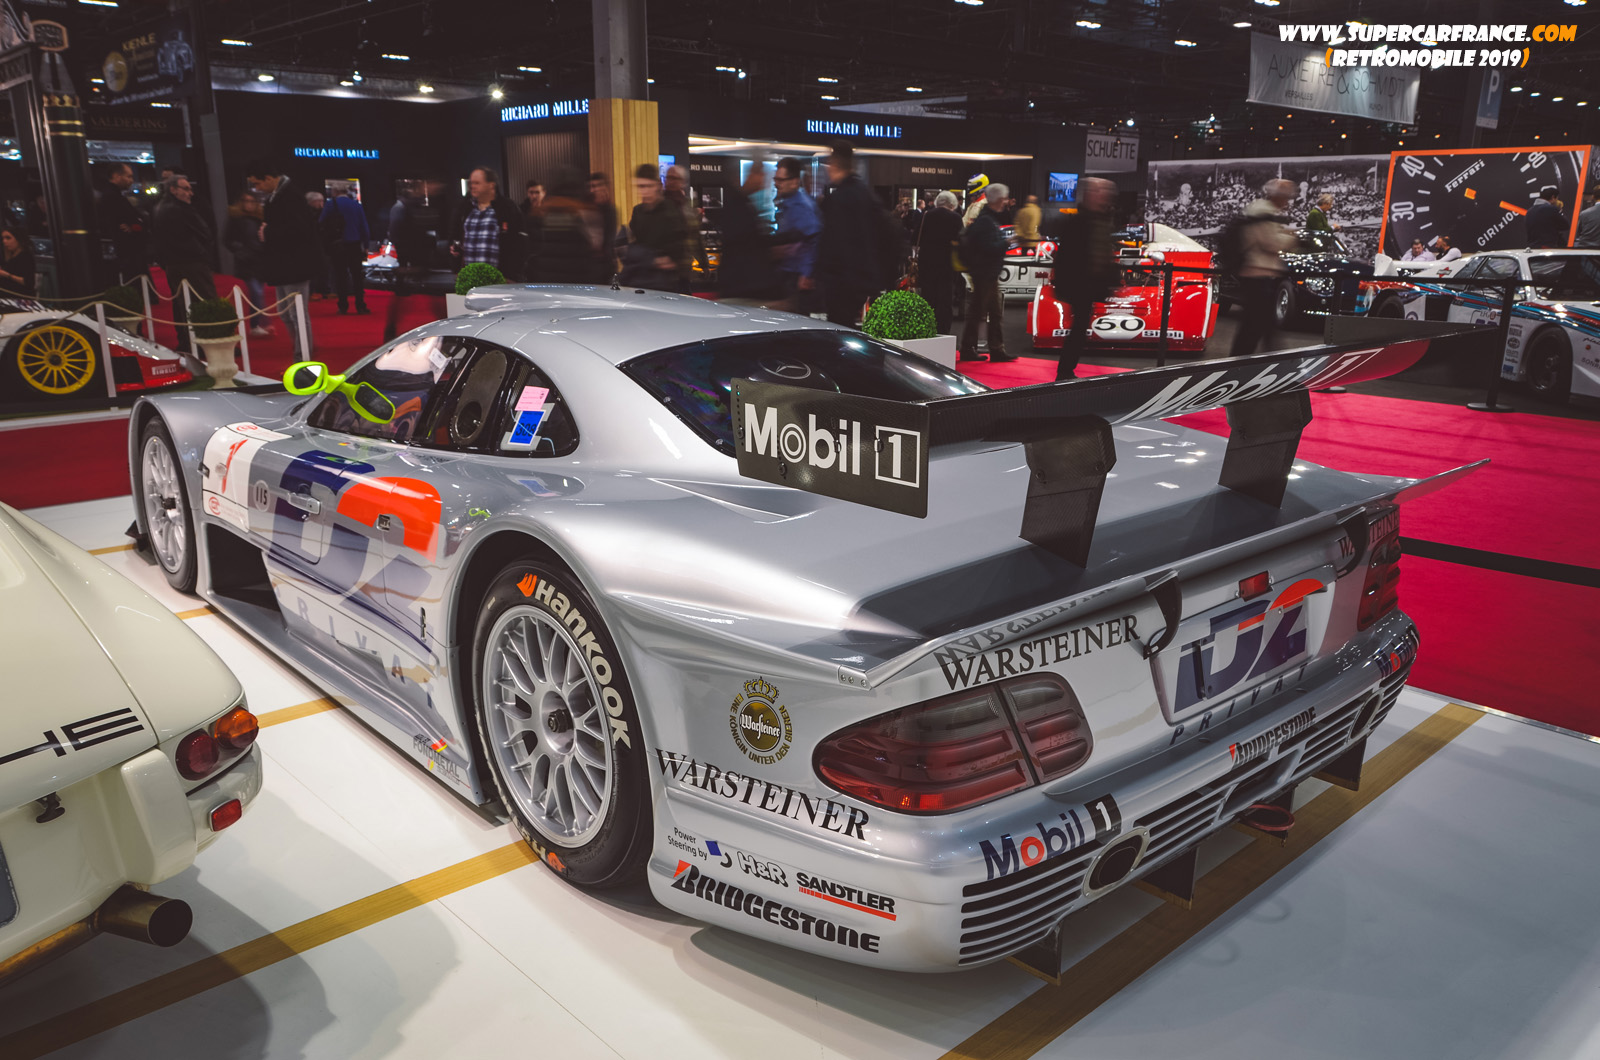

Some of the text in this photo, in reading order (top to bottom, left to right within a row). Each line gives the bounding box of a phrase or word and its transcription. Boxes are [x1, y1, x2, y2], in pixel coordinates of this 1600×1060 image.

[501, 98, 590, 122] RICHARD MILLE
[806, 119, 904, 139] RICHARD MILLE
[295, 147, 380, 160] RICHARD MILLE
[1087, 139, 1136, 160] SCHUETTE
[702, 164, 722, 172] MILLE
[911, 166, 954, 176] RICHARD MILLE
[1401, 155, 1425, 178] 40
[1445, 159, 1485, 193] Ferrari
[1391, 200, 1415, 221] 30
[1095, 318, 1143, 331] 50
[1109, 355, 1330, 426] Mobil
[745, 403, 902, 479] Mobil 1
[256, 485, 268, 506] 115
[535, 579, 632, 750] Hankook
[940, 614, 1141, 691] WARSTEINER
[1229, 706, 1317, 768] BRIDGESTONE
[413, 738, 460, 778] FONDMETAL
[748, 751, 777, 765] UNTER
[775, 743, 790, 761] DEN
[655, 747, 870, 841] WARSTEINER
[667, 835, 708, 860] Steering by
[674, 827, 697, 844] Power
[979, 801, 1112, 881] Mobil 1
[737, 851, 789, 888] H&R
[796, 872, 896, 914] SANDTLER
[671, 860, 880, 954] BRIDGESTONE
